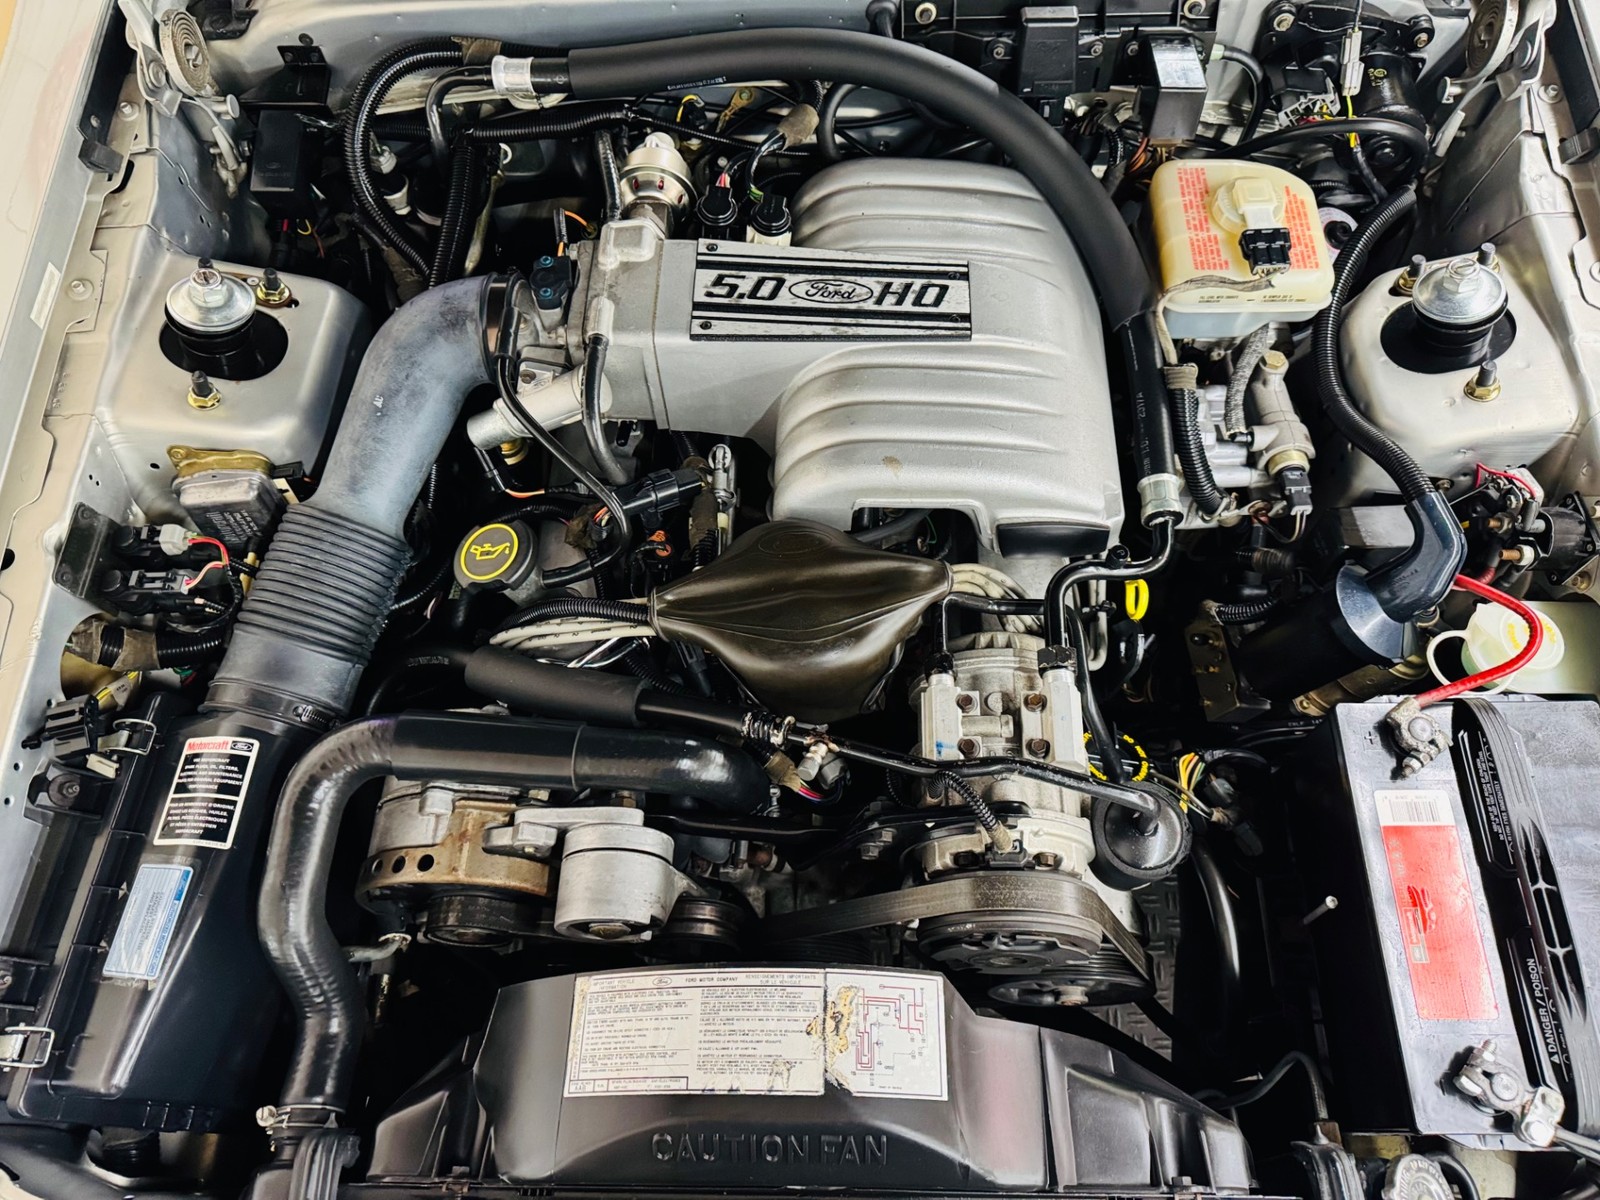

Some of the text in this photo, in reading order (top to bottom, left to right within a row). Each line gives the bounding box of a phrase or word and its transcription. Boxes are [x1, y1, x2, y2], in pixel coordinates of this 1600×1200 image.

[704, 272, 950, 308] 5.0 Ford HO
[186, 740, 230, 752] Motorcraft
[213, 778, 243, 786] EQUIPMENT
[1526, 958, 1544, 997] POISON
[1538, 1008, 1558, 1053] DANGER
[652, 1132, 888, 1165] CAUTION FAN
